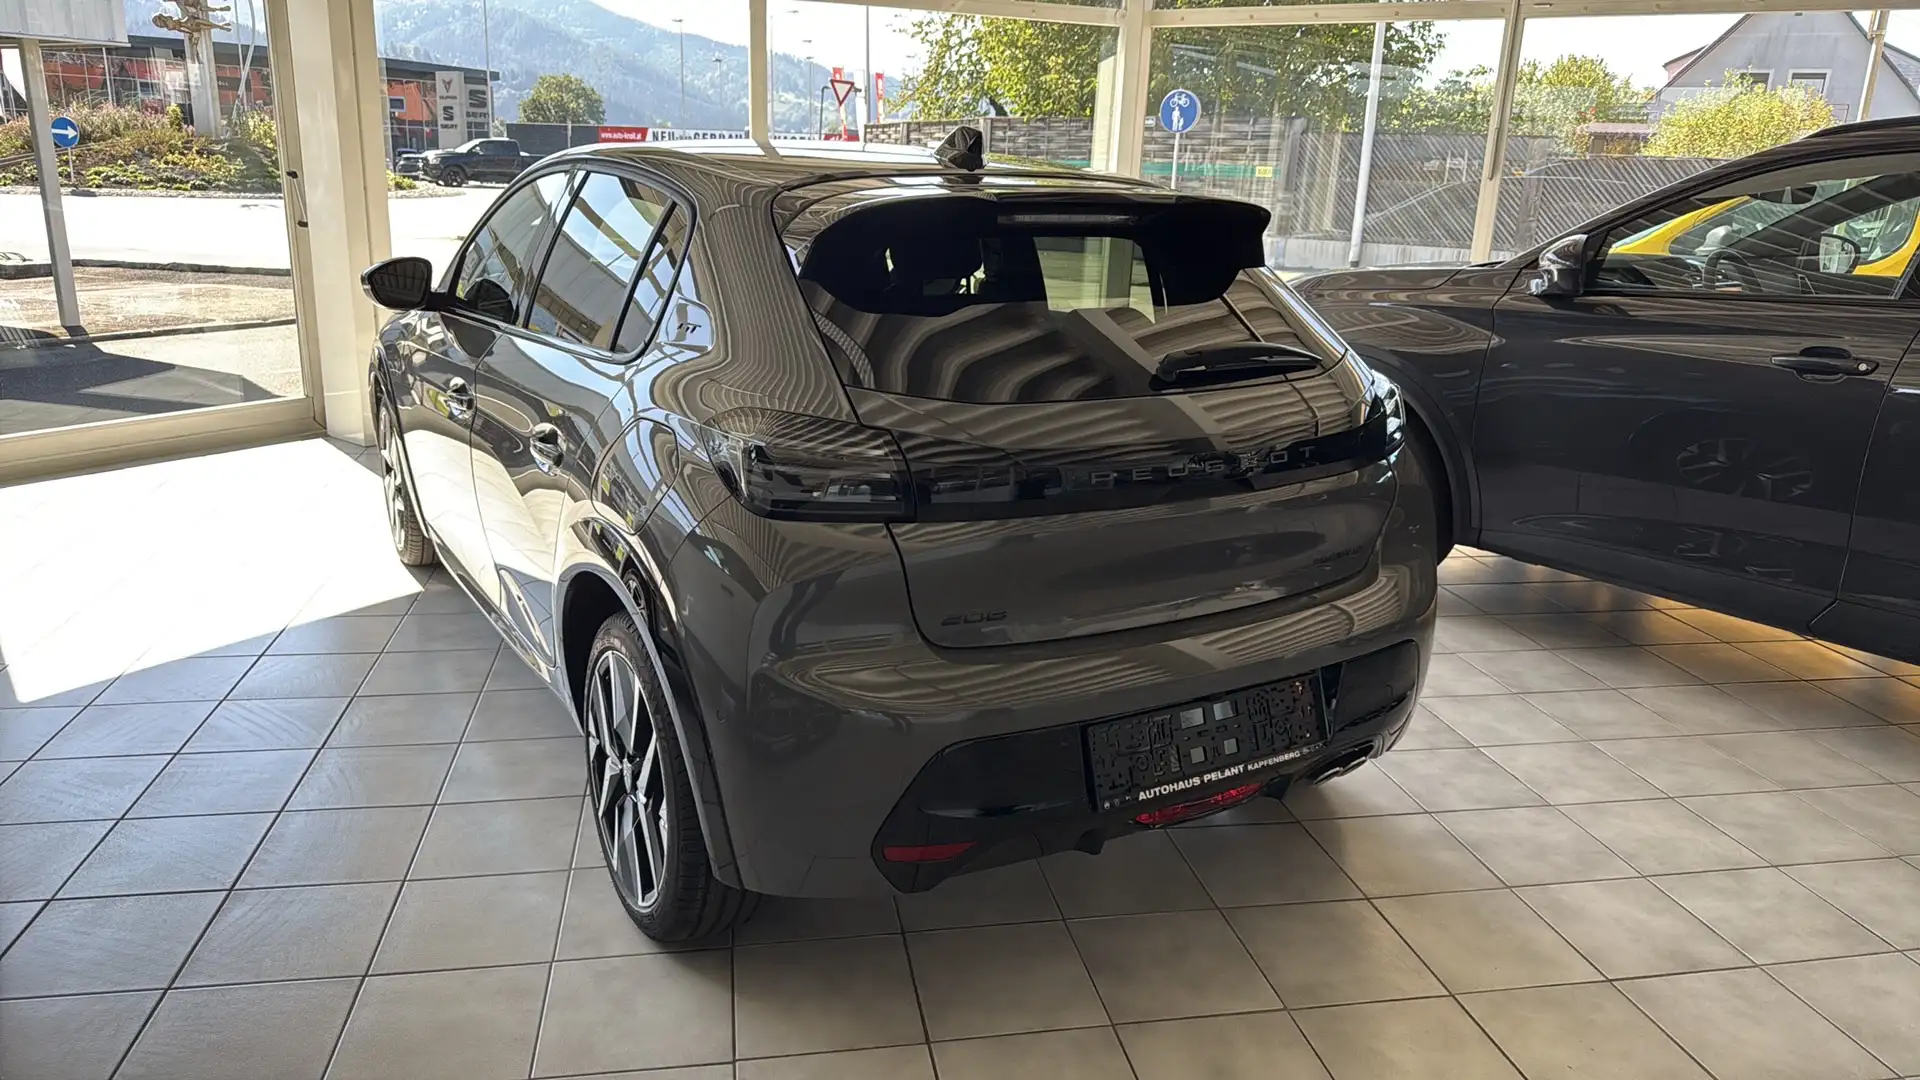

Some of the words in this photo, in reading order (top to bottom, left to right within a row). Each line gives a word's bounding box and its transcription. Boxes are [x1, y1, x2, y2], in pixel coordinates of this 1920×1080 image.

[1138, 777, 1201, 801] AUTOHAUS
[1203, 764, 1245, 784] PELANT
[1247, 750, 1301, 772] KAPFENBERG
